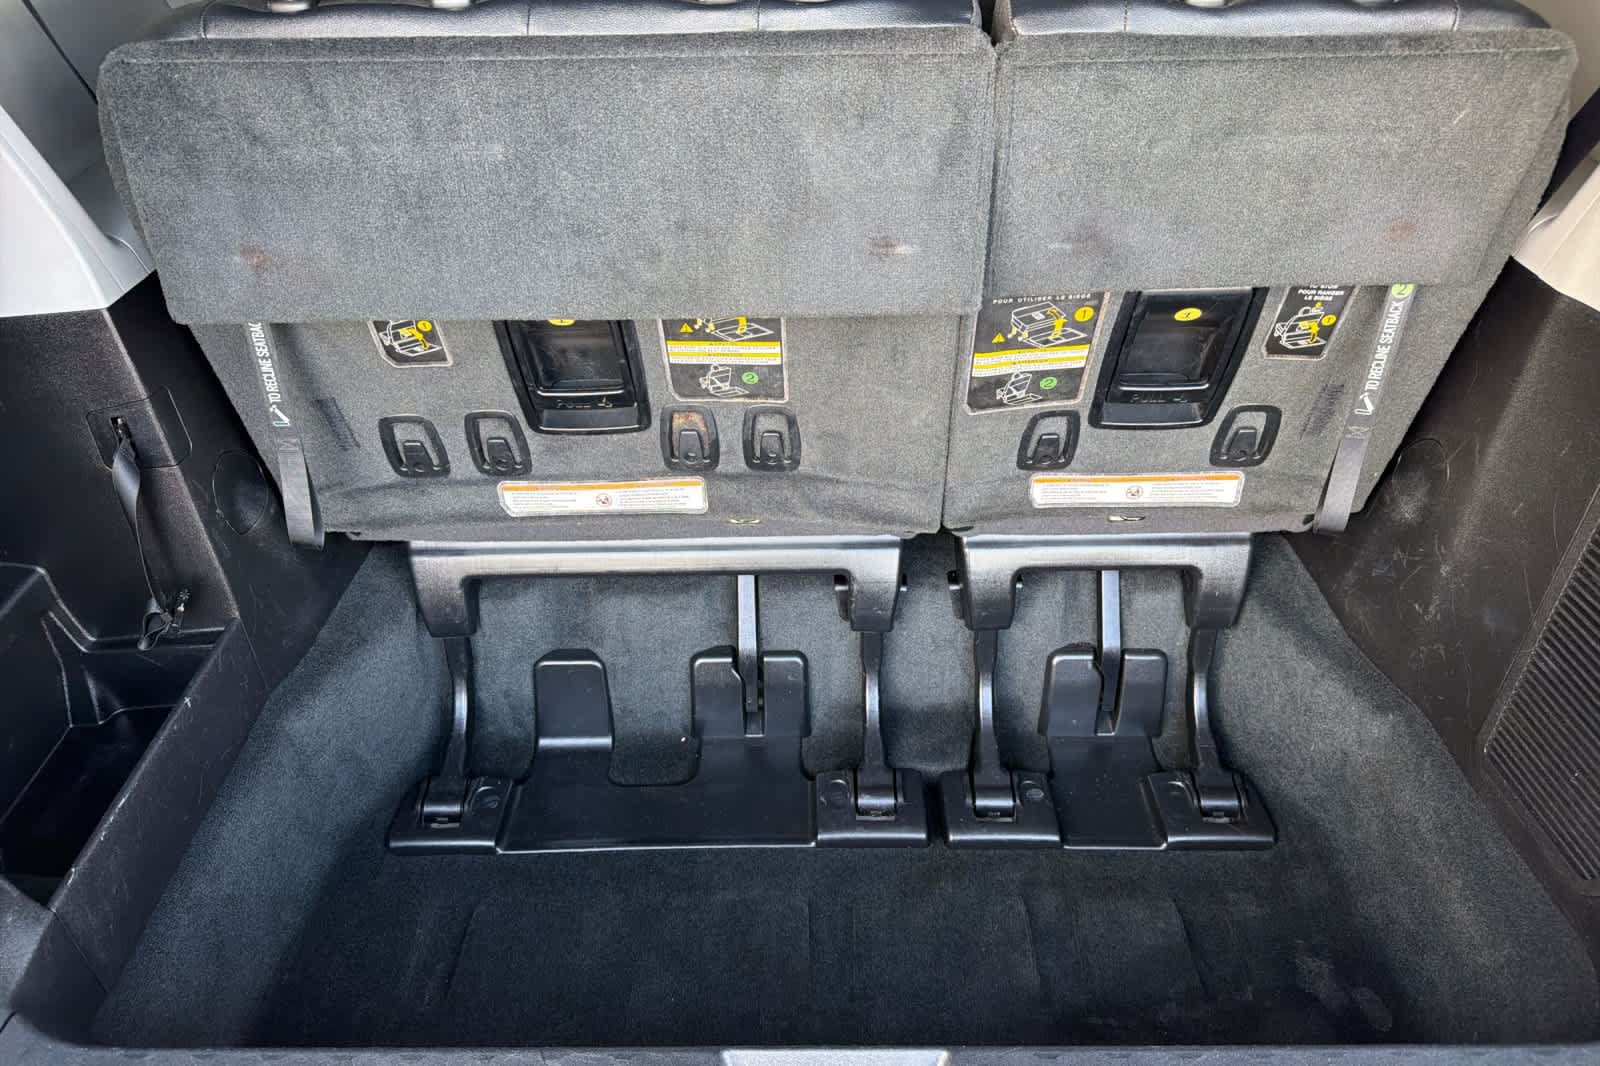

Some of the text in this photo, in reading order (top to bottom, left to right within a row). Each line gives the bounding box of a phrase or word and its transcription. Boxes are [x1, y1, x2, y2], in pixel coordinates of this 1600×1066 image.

[247, 321, 282, 404] TO RECLINE SEATBAC
[1365, 300, 1405, 391] TO RECLINE SEATBACK
